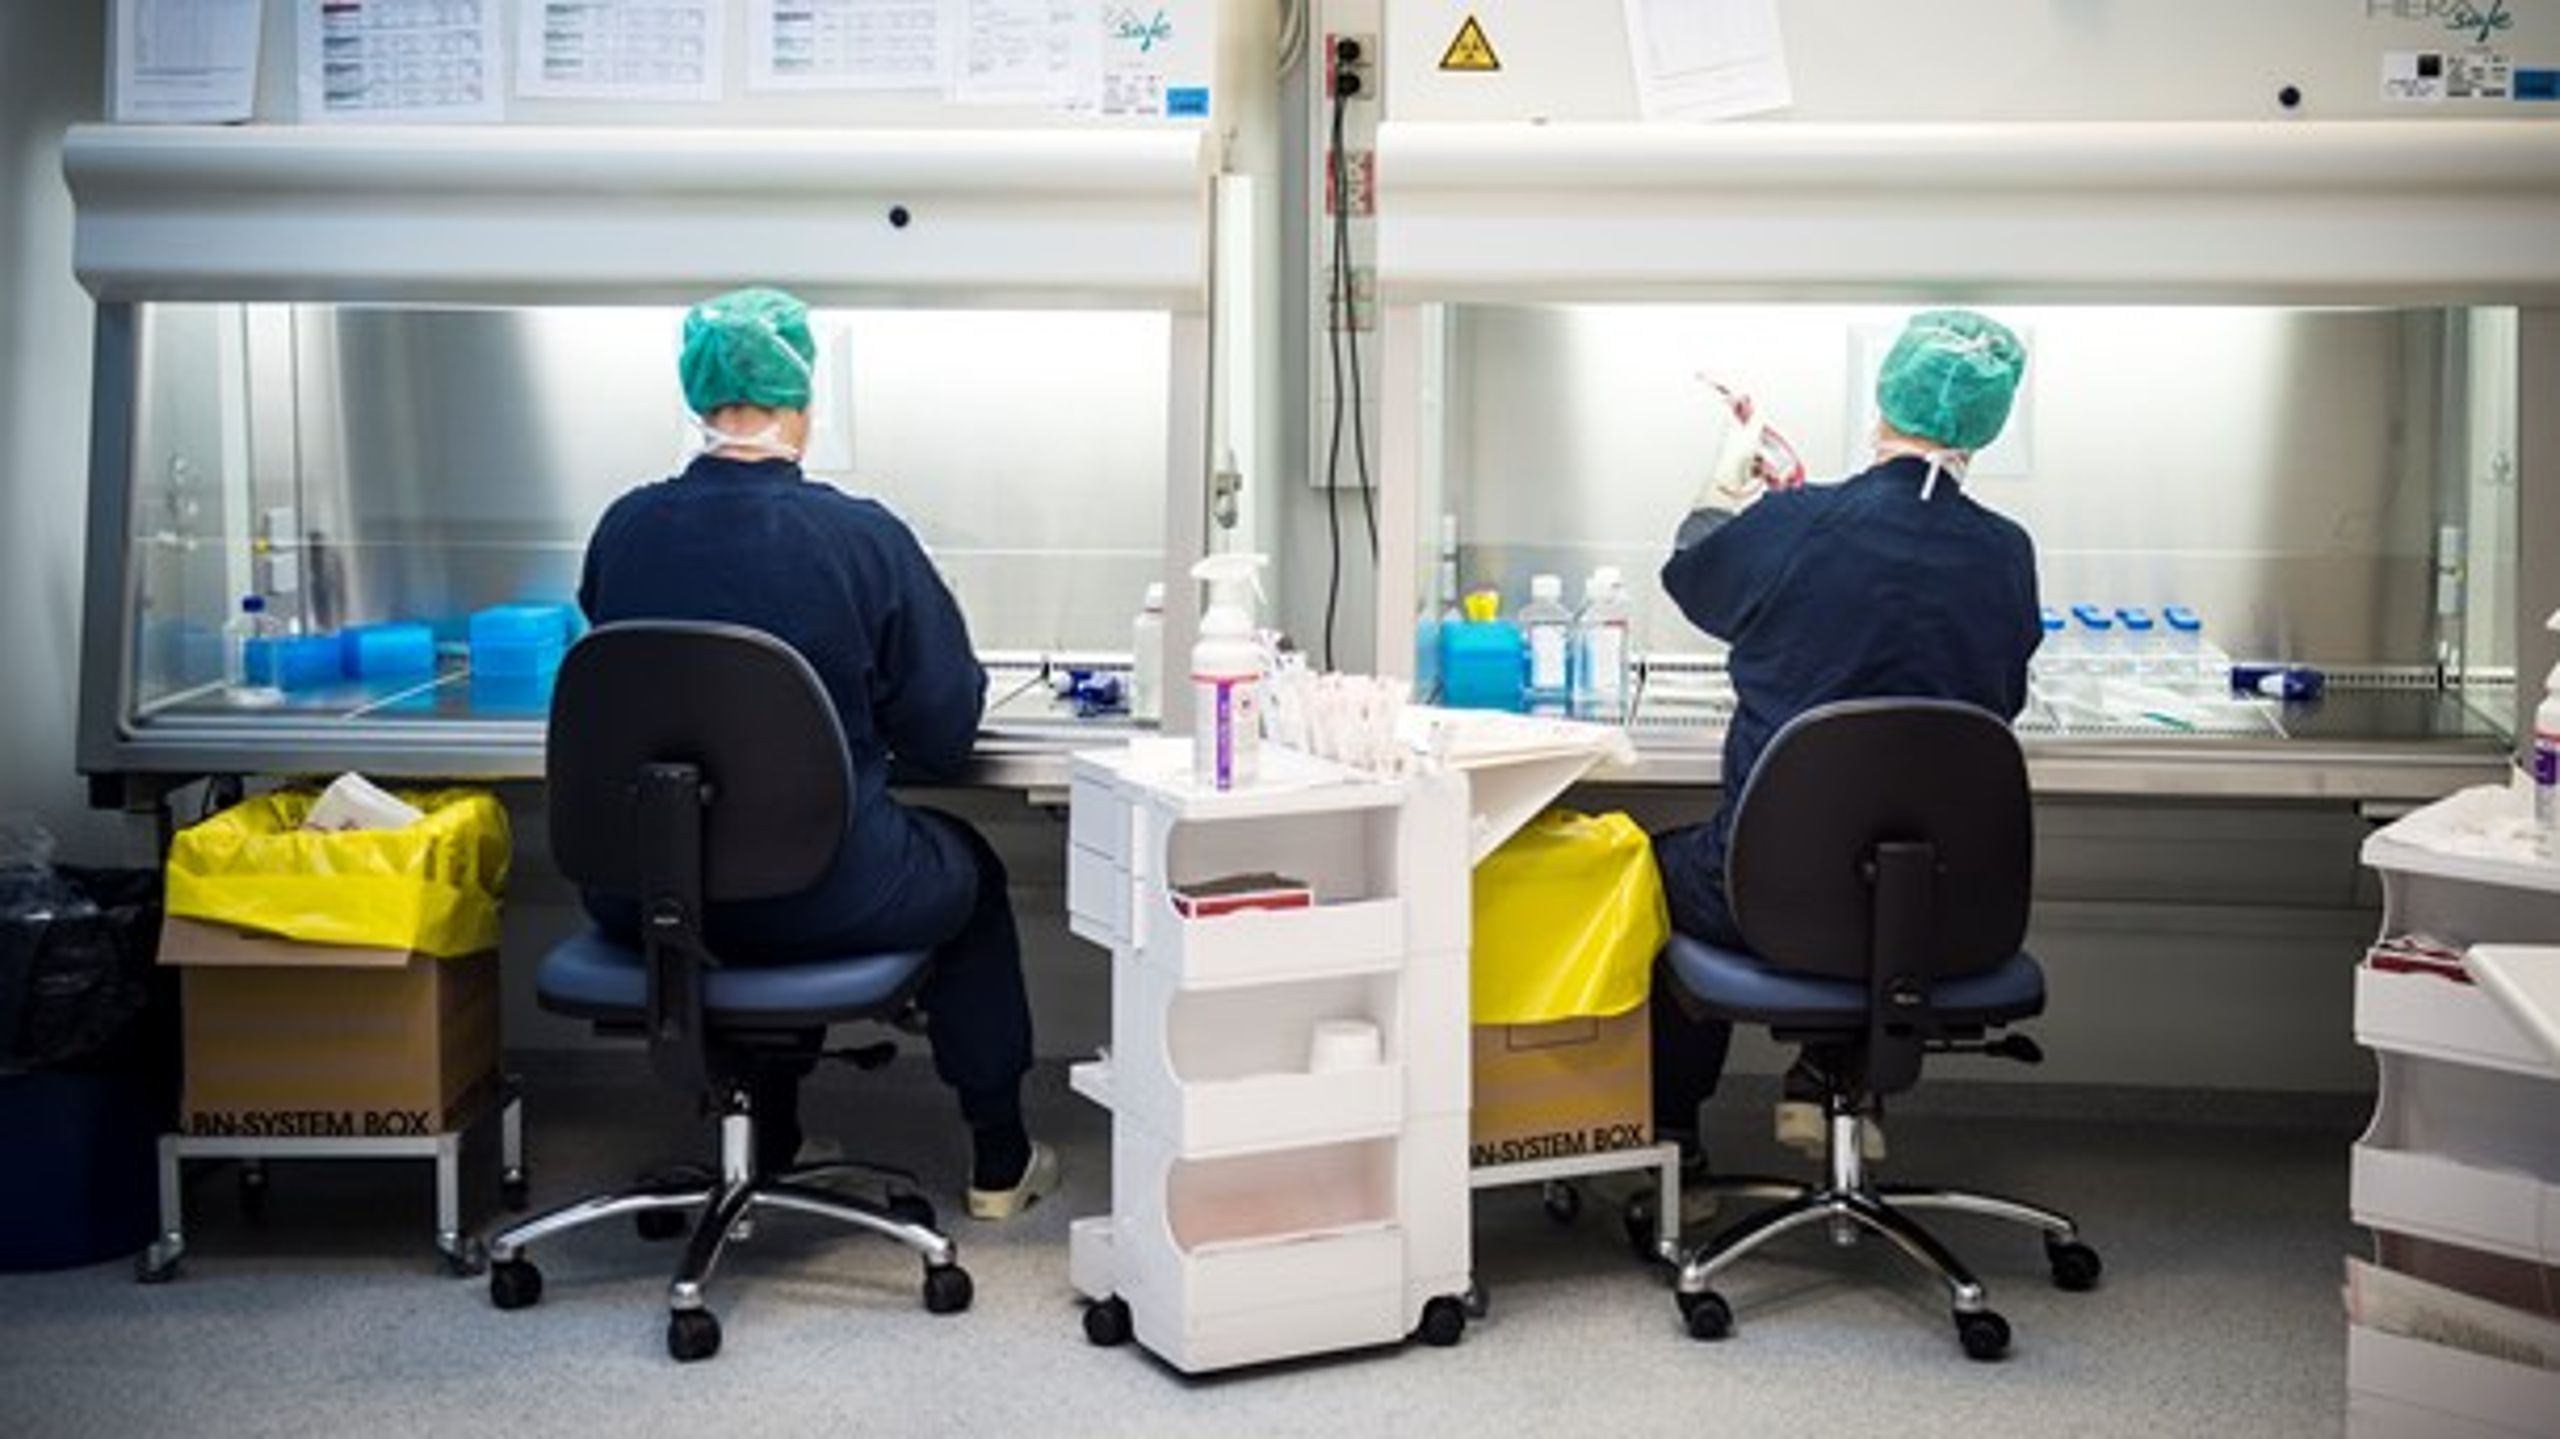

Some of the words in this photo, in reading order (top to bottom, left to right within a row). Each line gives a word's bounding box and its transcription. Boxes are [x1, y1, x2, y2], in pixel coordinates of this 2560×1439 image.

[1110, 10, 1173, 52] safe
[364, 1110, 430, 1137] BOX
[1593, 1123, 1645, 1152] BOX
